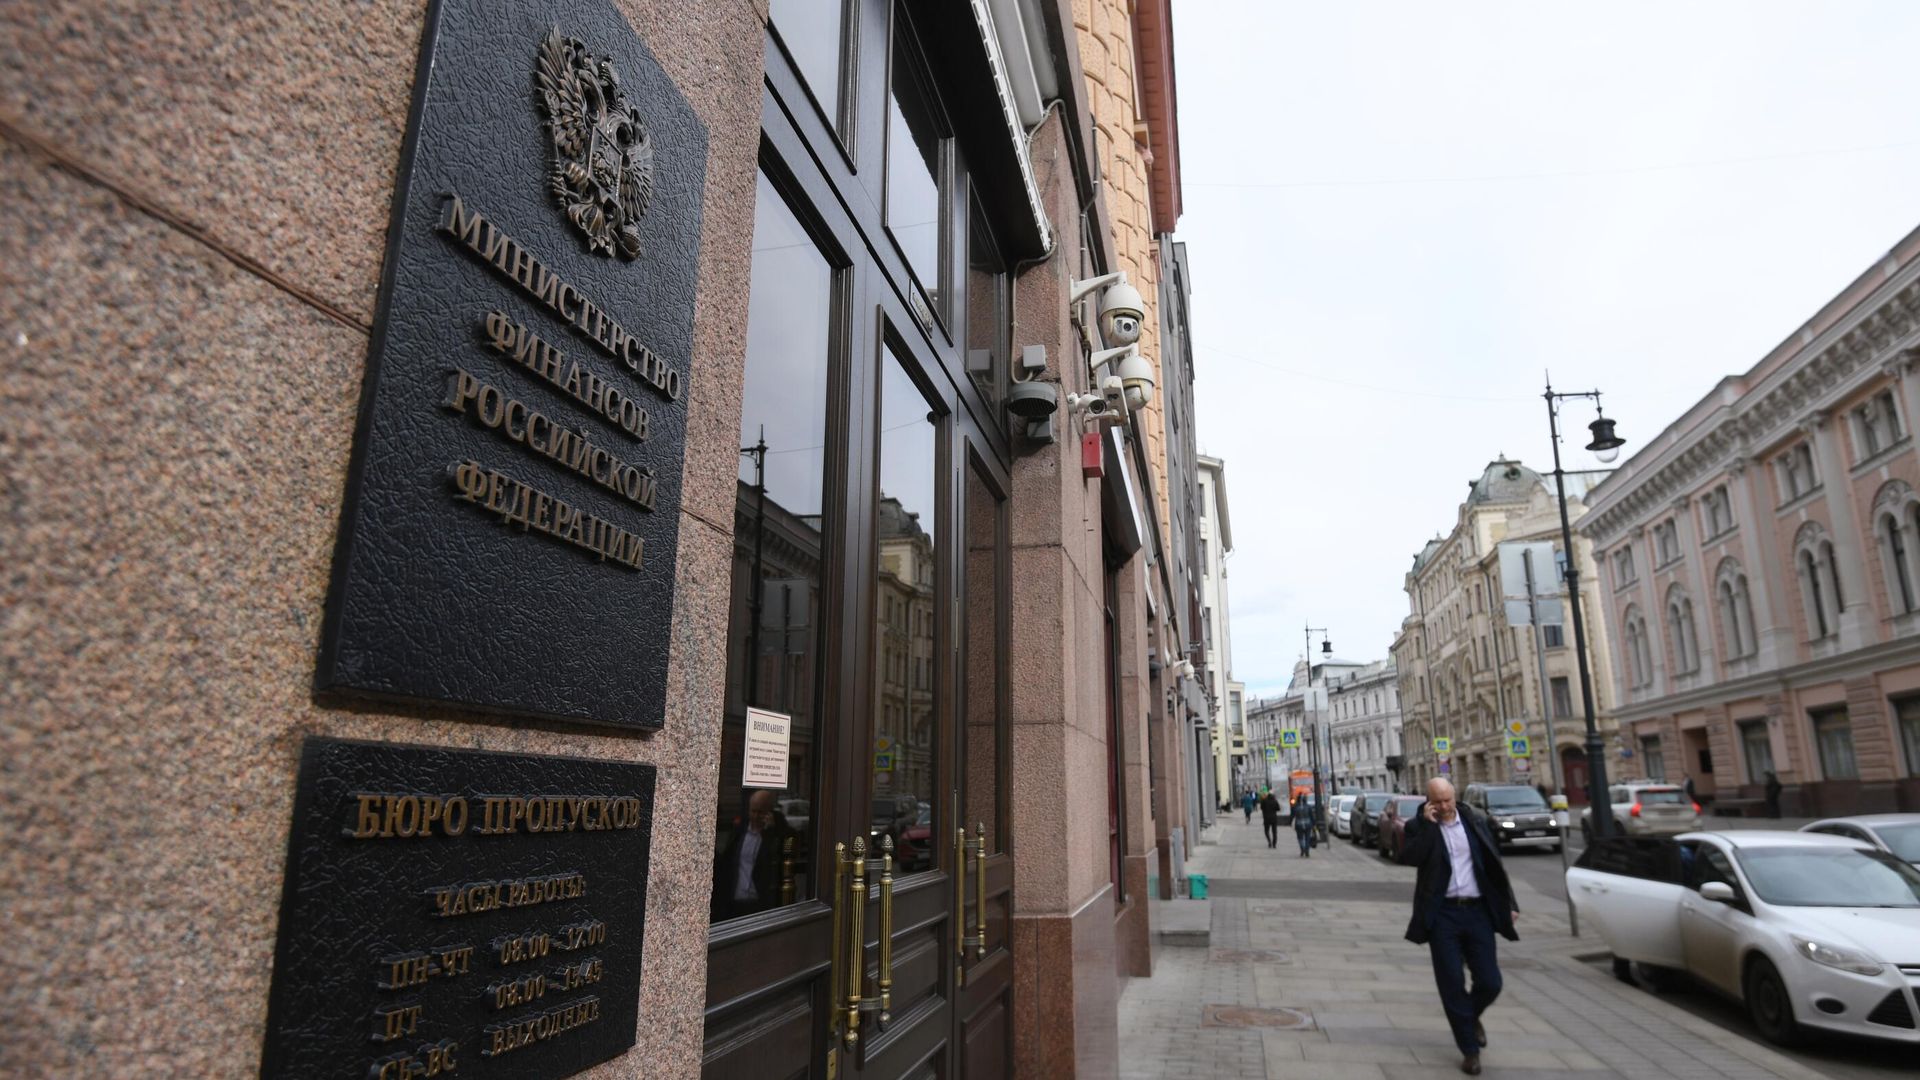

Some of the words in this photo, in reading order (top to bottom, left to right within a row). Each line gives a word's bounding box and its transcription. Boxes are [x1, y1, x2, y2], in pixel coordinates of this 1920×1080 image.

[445, 195, 682, 401] МИНИСТЕРСТВО
[483, 309, 650, 442] ФИНАНСОВ
[449, 367, 657, 512] РОССИЙСКОЙ
[454, 458, 646, 571] ФЕДЕРАЦИИ
[352, 794, 469, 838] БЮРО
[480, 796, 641, 834] ПРОПУСКОВ
[436, 885, 501, 917] ЧАСЫ
[389, 947, 474, 989] ПН-ЧТ
[384, 1004, 422, 1041] ПТ
[490, 997, 601, 1057] ВЫХОДНЫЕ
